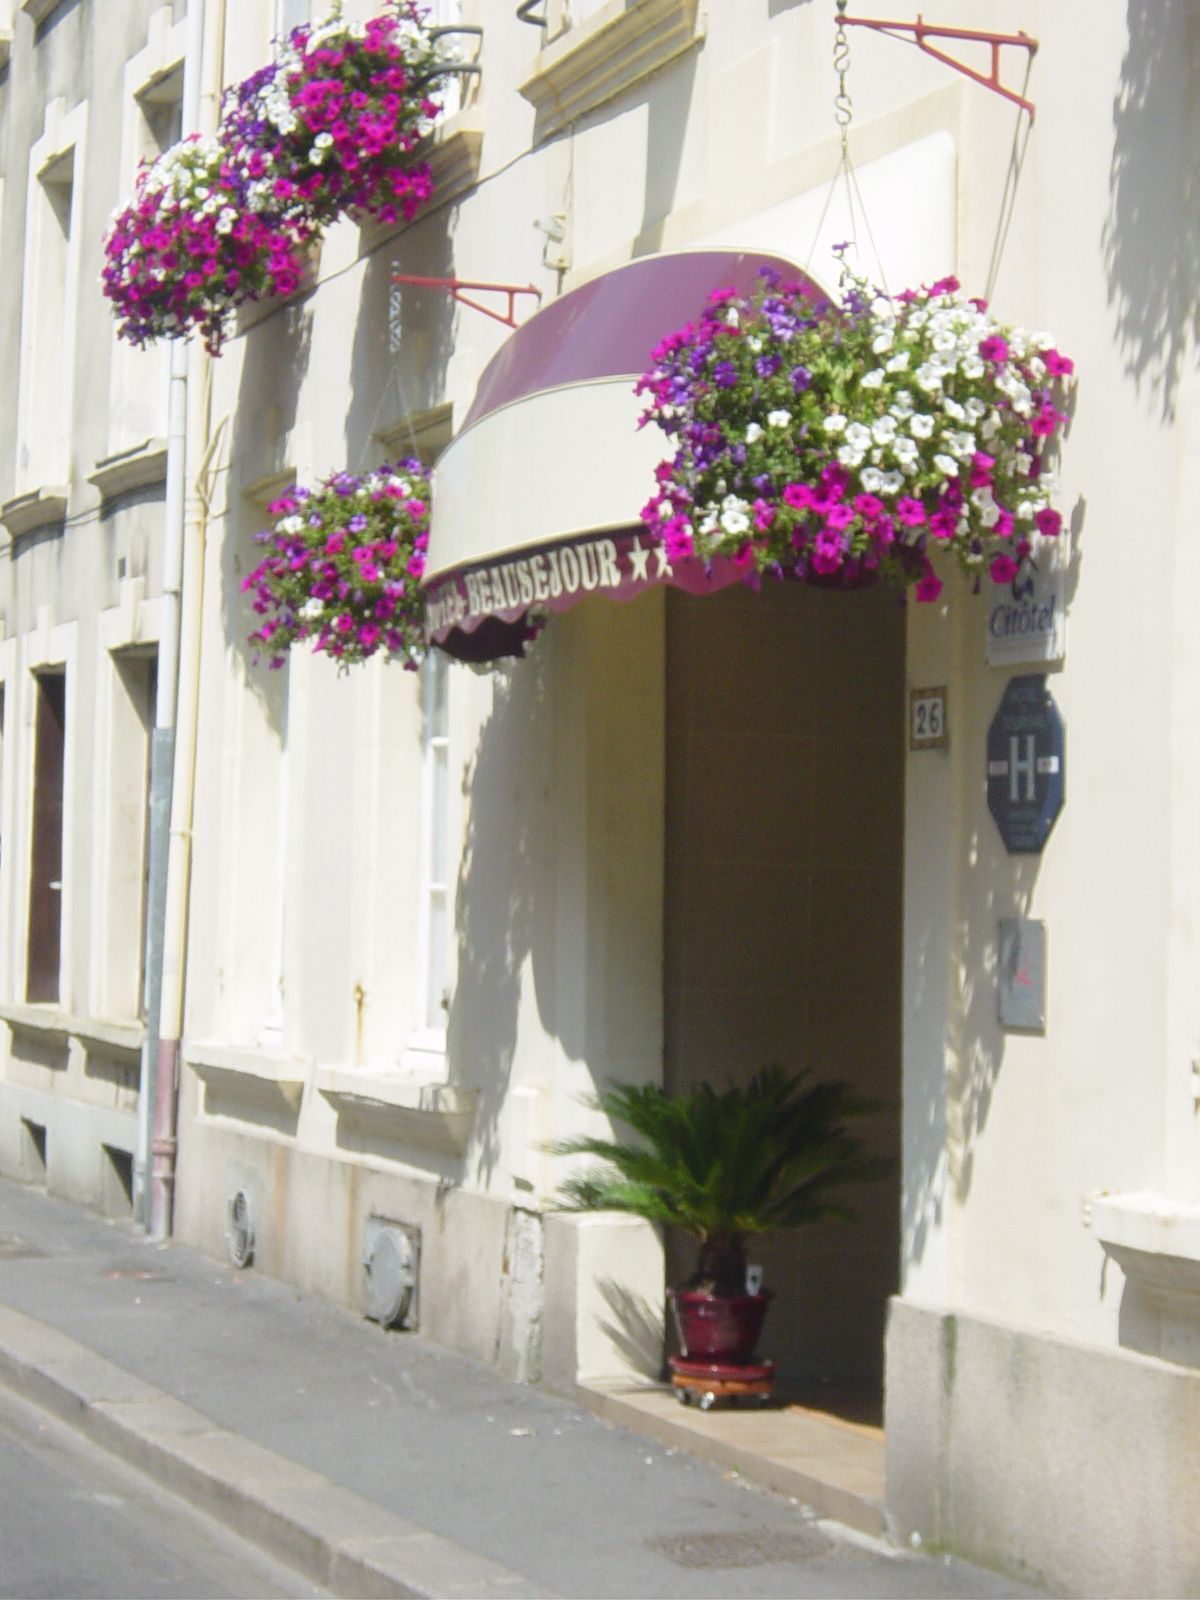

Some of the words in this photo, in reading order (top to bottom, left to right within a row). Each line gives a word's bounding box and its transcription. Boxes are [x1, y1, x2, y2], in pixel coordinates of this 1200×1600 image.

[462, 537, 622, 617] BEAUSEJOUR
[917, 702, 941, 736] 26
[1009, 734, 1036, 802] H
